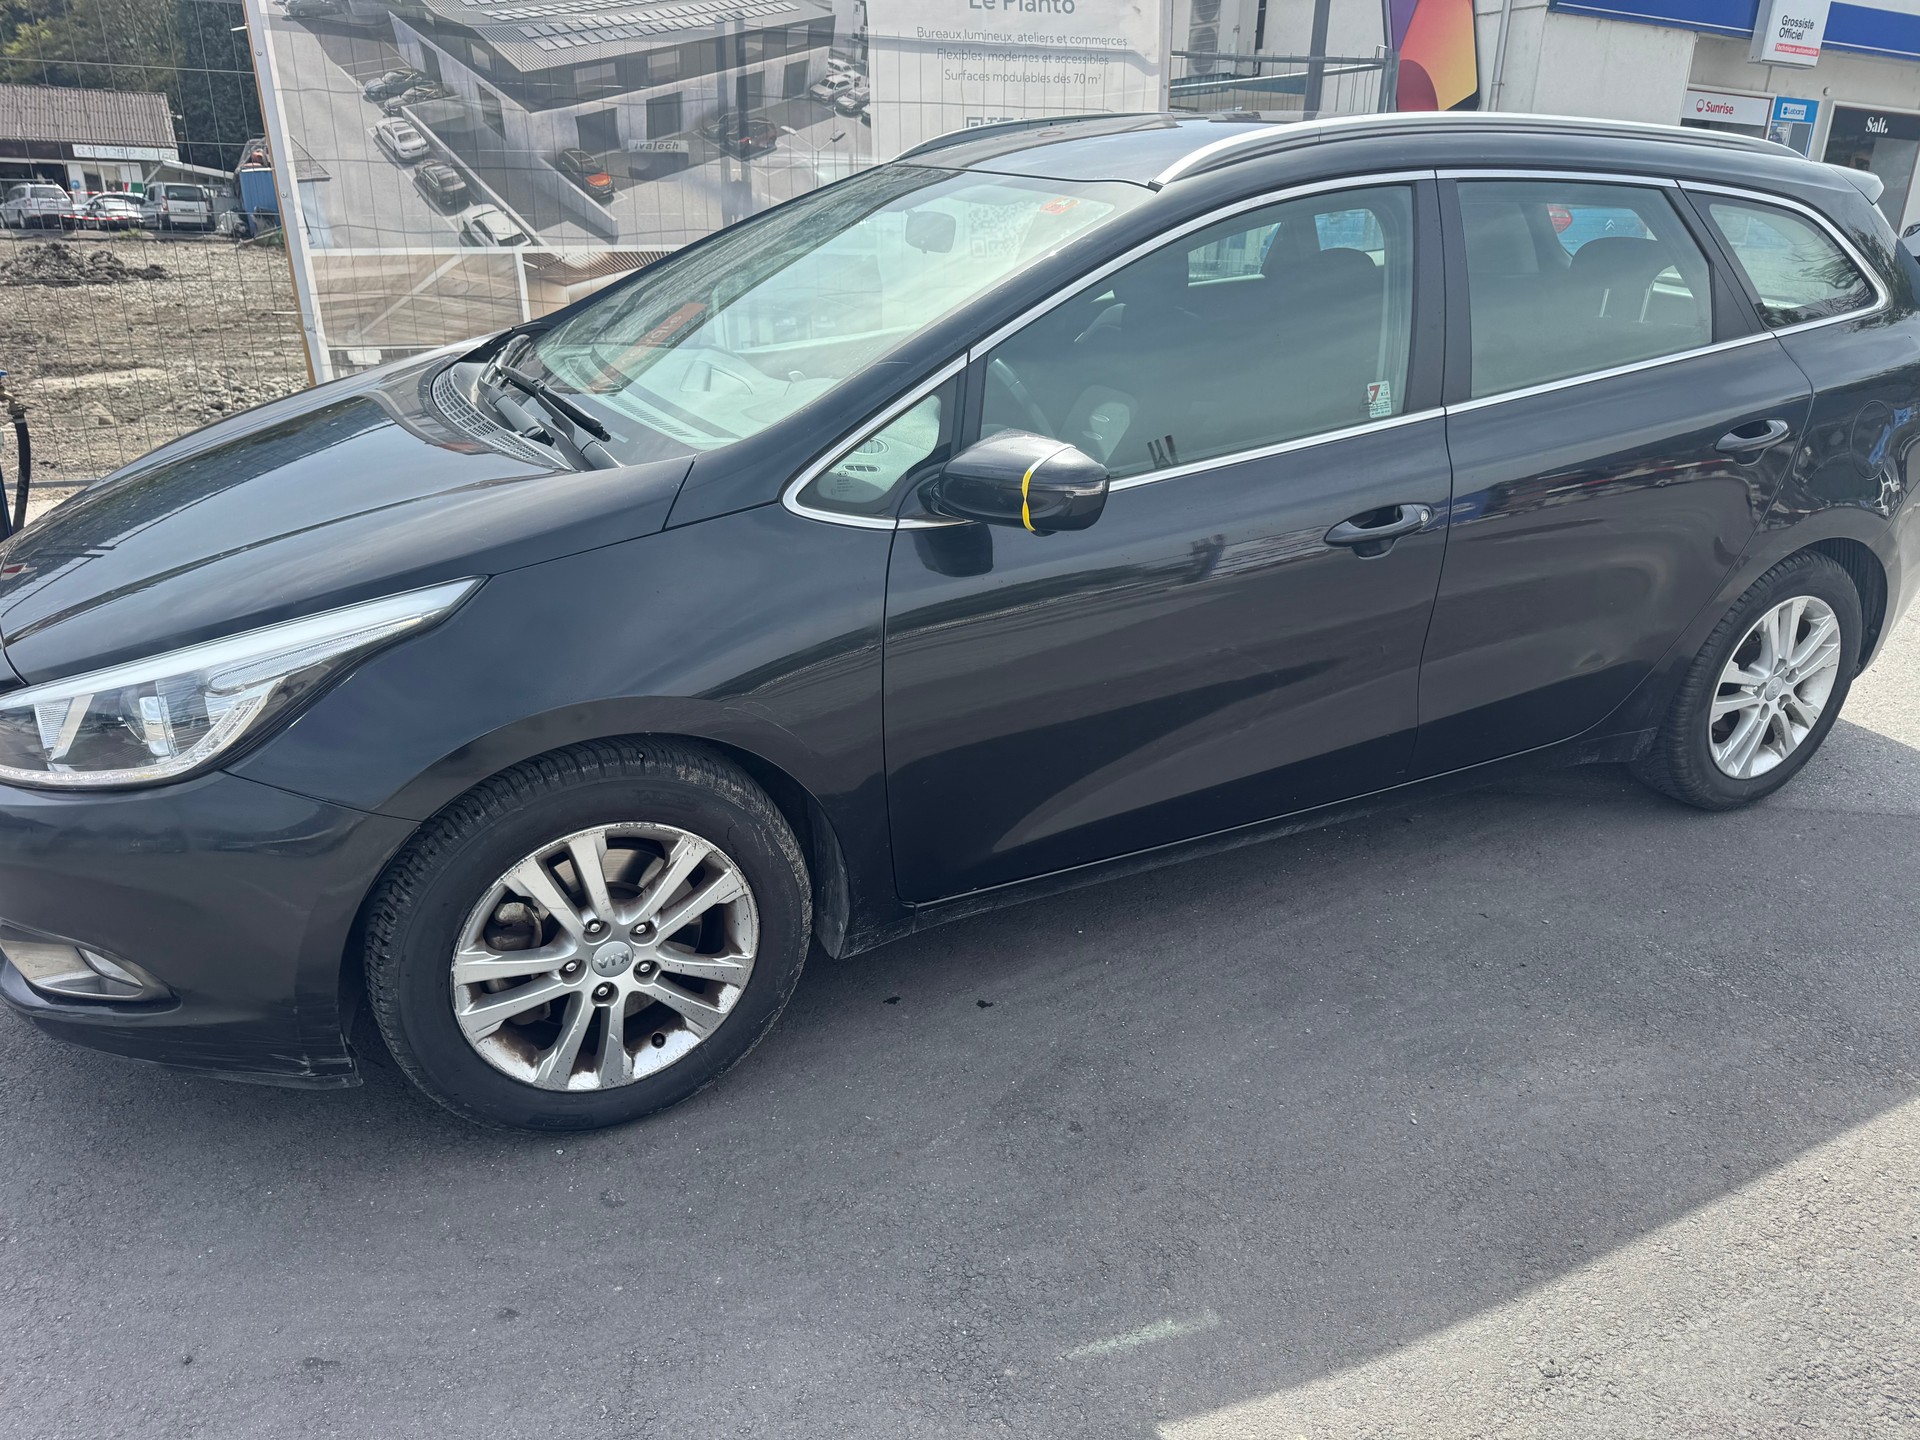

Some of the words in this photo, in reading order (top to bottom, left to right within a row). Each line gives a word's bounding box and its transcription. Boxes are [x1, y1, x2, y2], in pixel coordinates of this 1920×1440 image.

[1781, 14, 1815, 30] Grossiste
[916, 27, 962, 40] Bureaux
[964, 29, 1015, 43] lumineux,
[1017, 32, 1055, 44] ateliers
[1056, 35, 1067, 45] et
[1069, 36, 1128, 47] commerces
[1778, 27, 1805, 41] Officiel
[936, 48, 985, 63] Flexibles,
[987, 51, 1039, 64] modernes
[1041, 53, 1052, 64] et
[1054, 53, 1110, 66] accessibles
[944, 69, 990, 82] Surfaces
[992, 71, 1051, 84] modulables
[1073, 73, 1086, 85] 70
[1705, 101, 1734, 115] Sunrise
[1788, 107, 1805, 116] Lebara
[1865, 116, 1889, 134] Salt.
[596, 950, 630, 969] KIA
